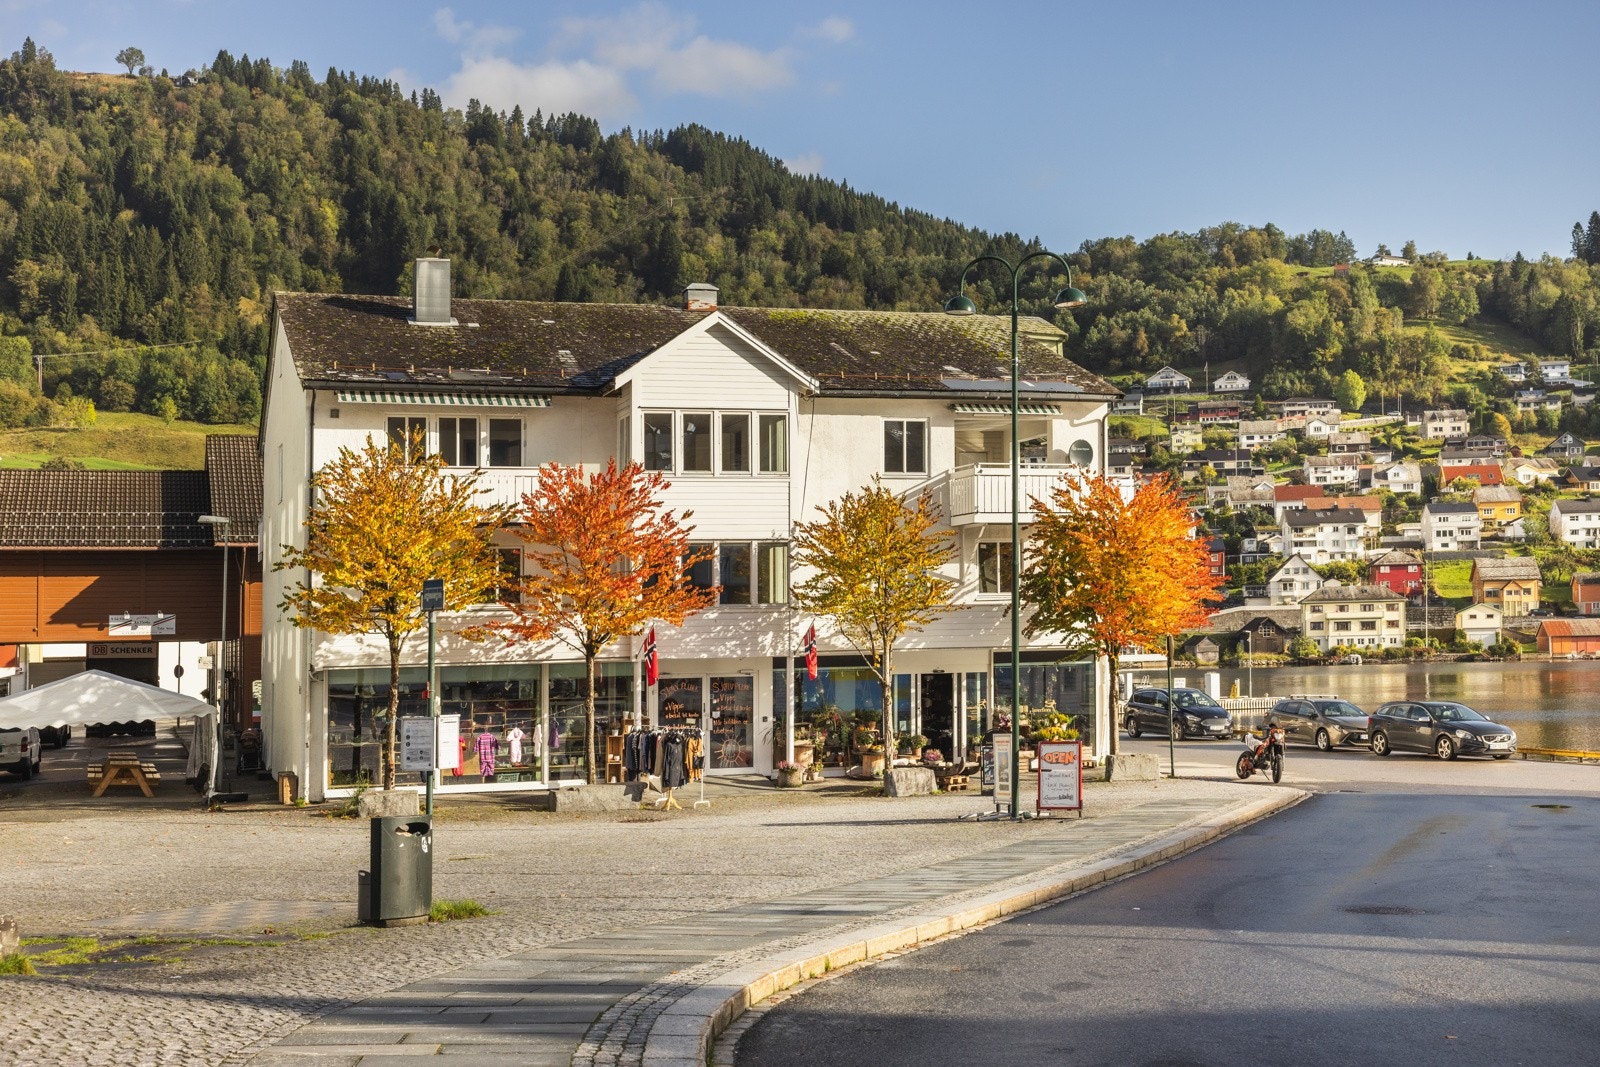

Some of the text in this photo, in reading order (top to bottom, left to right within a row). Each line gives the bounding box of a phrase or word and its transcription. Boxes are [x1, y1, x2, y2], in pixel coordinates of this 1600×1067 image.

[94, 646, 153, 654] DB SCHENKER
[1044, 751, 1074, 765] OPEN
